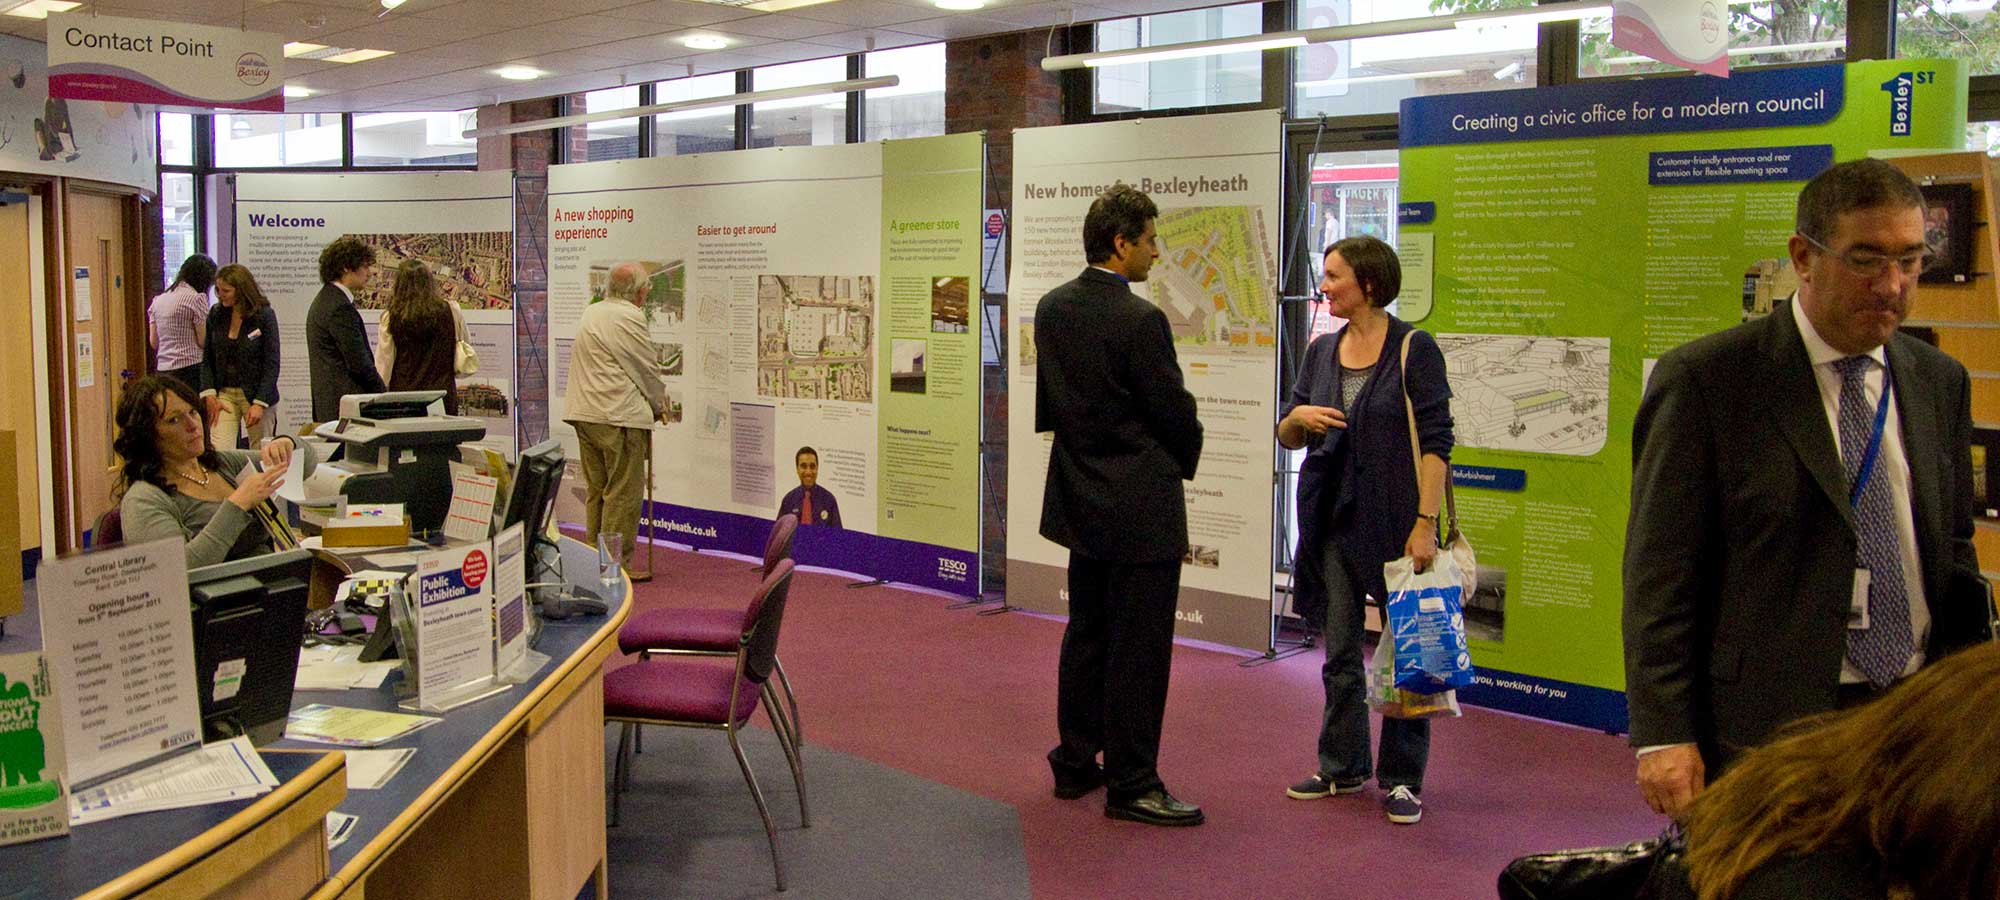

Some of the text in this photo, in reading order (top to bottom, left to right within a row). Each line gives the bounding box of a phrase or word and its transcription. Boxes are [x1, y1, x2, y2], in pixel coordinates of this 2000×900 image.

[65, 27, 214, 58] Contact Point
[1916, 71, 1936, 84] ST
[1452, 89, 1826, 132] Creating a civic office for a modern council
[1893, 77, 1912, 134] Bexley
[1657, 152, 1792, 166] Customer-friendly entrance and rear
[1657, 165, 1788, 178] extension for flexible meeting space
[1025, 183, 1058, 200] New
[1061, 182, 1110, 198] homes
[1141, 174, 1248, 198] Bexleyheath
[249, 214, 326, 228] Welcome
[554, 206, 634, 224] A new shopping
[697, 223, 776, 238] Easier to get around
[890, 219, 960, 234] A greener store
[554, 226, 608, 244] experience
[1452, 470, 1496, 481] Refurbishment
[1184, 488, 1224, 498] exleyheath
[640, 517, 718, 538] coexleyheath.co.uk
[85, 556, 146, 576] Central Library
[938, 558, 966, 572] TESCO
[423, 576, 449, 592] Public
[89, 592, 150, 612] Opening hours
[423, 586, 466, 605] Exhibition
[108, 603, 144, 618] September
[146, 598, 161, 608] 2011
[424, 612, 454, 626] Bexleyheath
[75, 653, 102, 664] Tuesday
[1476, 676, 1568, 699] you, working for you
[0, 704, 34, 720] OUT
[19, 816, 38, 826] free
